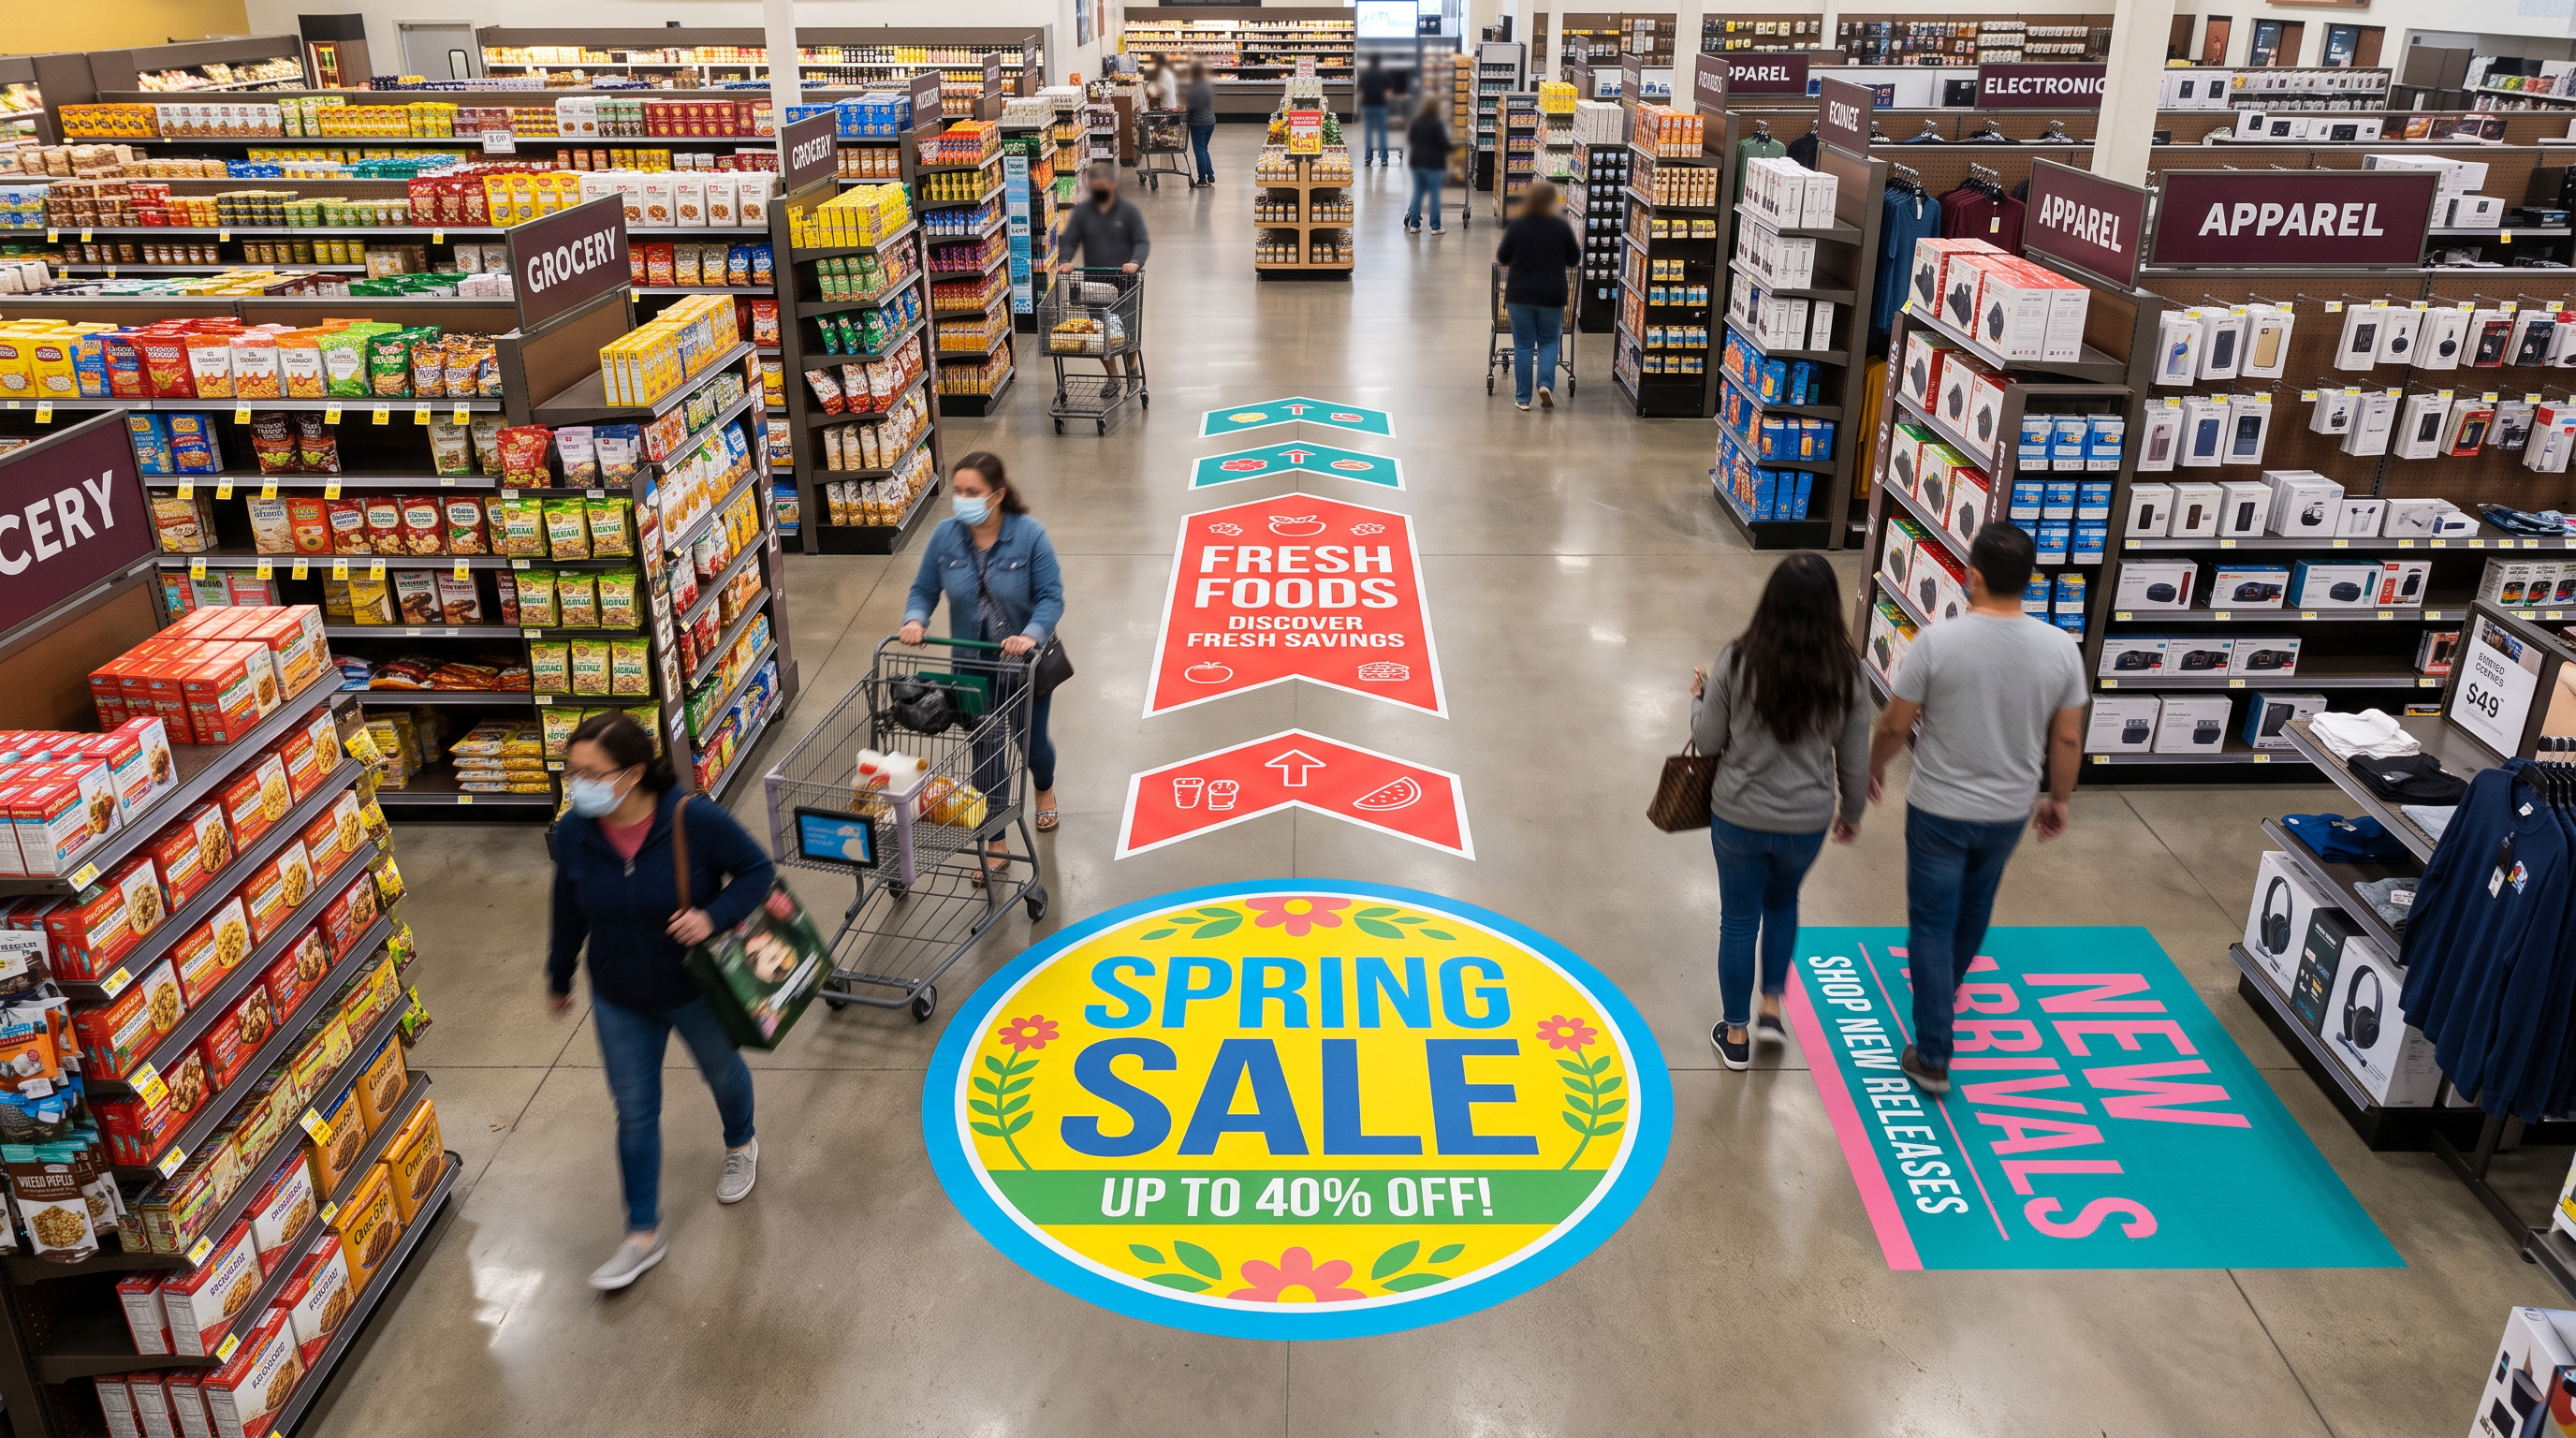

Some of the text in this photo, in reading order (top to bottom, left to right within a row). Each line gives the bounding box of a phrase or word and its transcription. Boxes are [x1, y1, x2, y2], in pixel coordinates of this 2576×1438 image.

[2038, 193, 2122, 254] APPAREL
[2198, 202, 2384, 237] APPAREL
[527, 226, 616, 293] GROCERY
[1200, 545, 1393, 574] FRESH
[1194, 578, 1398, 609] FOODS
[1187, 633, 1405, 648] FRESH SAVINGS
[1228, 616, 1363, 630] DISCOVER
[2466, 682, 2499, 718] $49
[1084, 956, 1511, 1029] SPRING
[2019, 973, 2252, 1129] NEW
[1060, 1037, 1540, 1158] SALE
[1808, 955, 1969, 1215] SHOP NEW RELEASES
[1101, 1177, 1494, 1217] UP TO 40% OFF!
